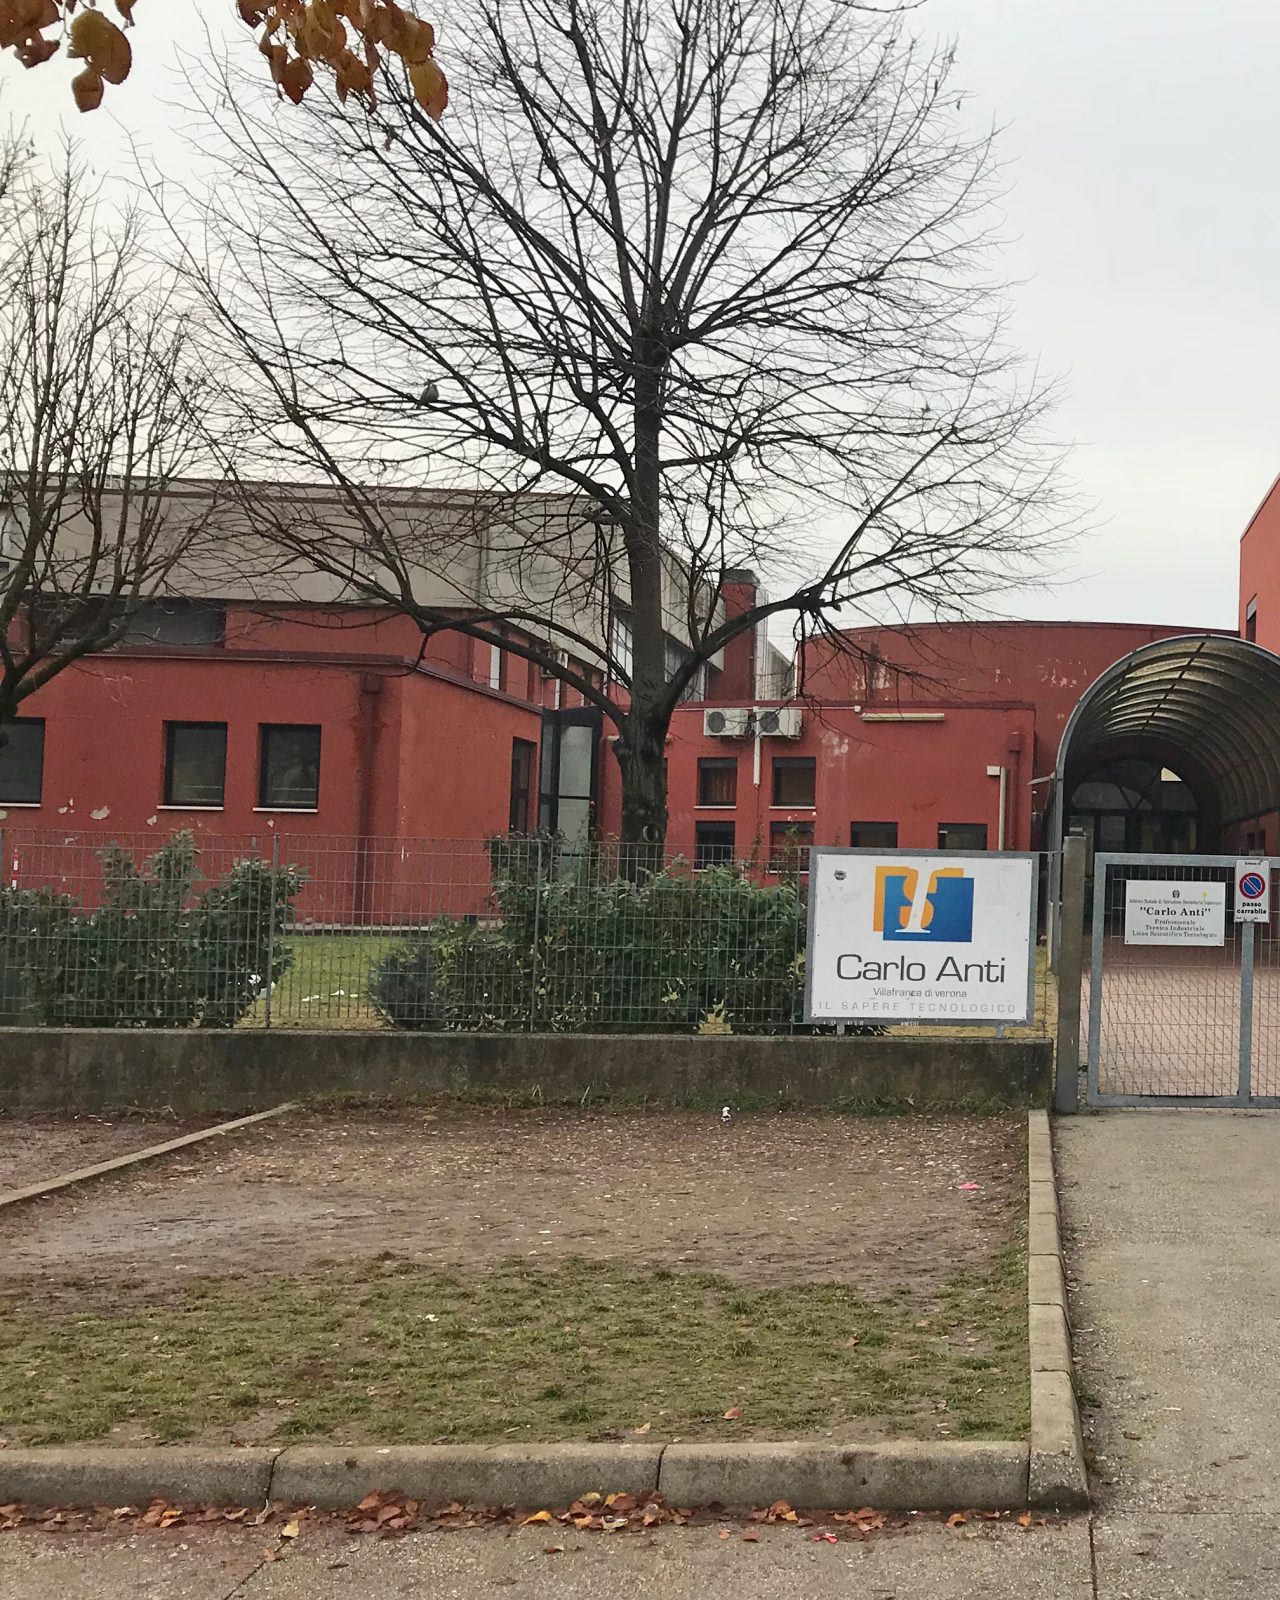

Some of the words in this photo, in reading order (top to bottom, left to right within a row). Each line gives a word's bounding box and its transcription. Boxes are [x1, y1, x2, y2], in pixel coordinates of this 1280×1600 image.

[837, 953, 926, 982] Carlo
[935, 956, 1006, 983] Anti
[873, 987, 922, 997] Villafranca
[924, 988, 933, 997] di
[935, 990, 967, 998] verona
[819, 1001, 832, 1010] IL
[841, 1001, 899, 1011] SAPERE
[910, 1003, 1016, 1013] TECNOLOGICO
